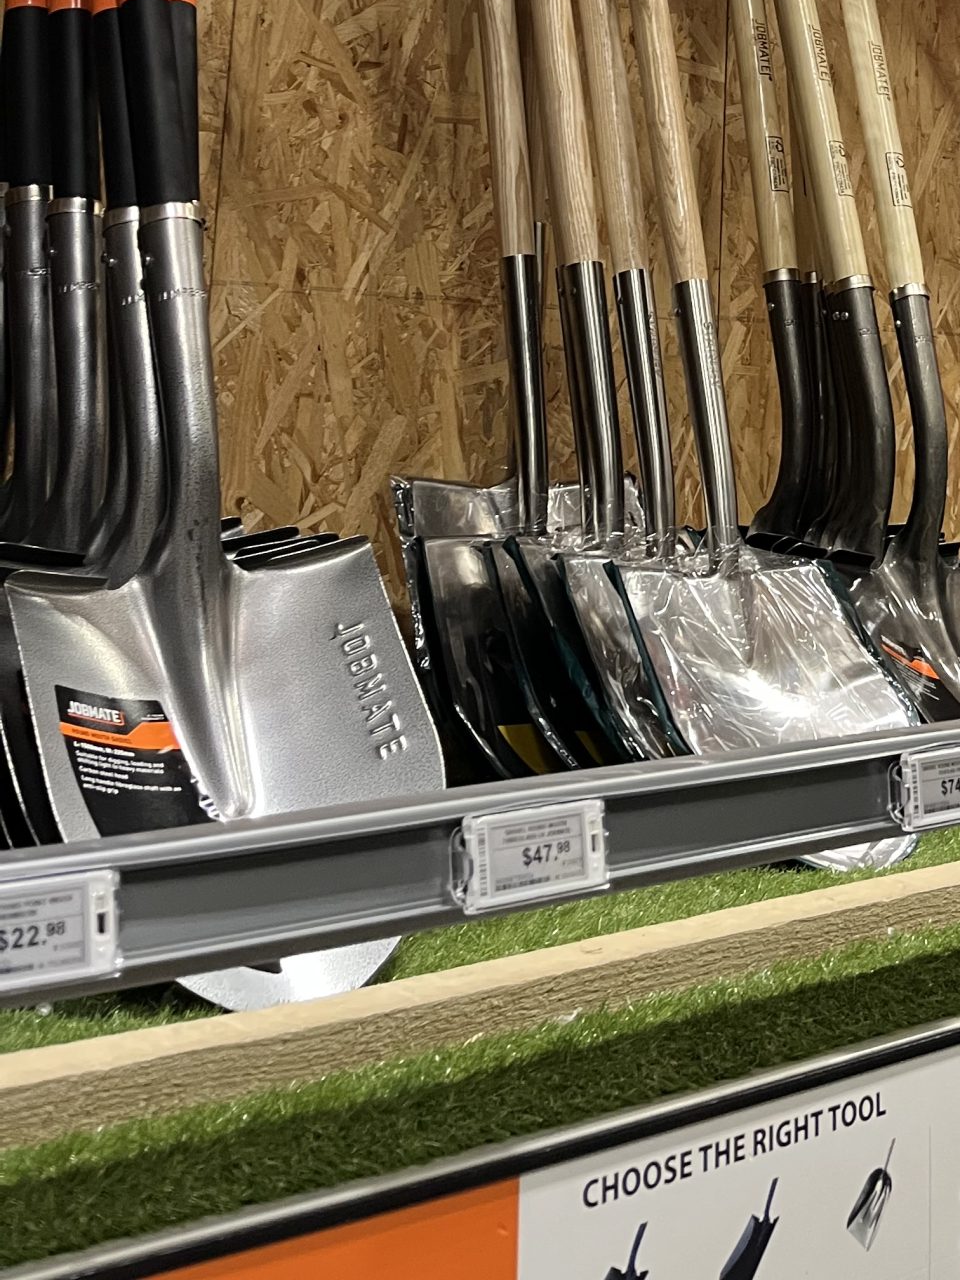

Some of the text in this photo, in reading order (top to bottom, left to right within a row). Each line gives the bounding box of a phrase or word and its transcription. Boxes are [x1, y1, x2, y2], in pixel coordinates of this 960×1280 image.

[755, 20, 771, 74] JOBMATE
[811, 25, 829, 80] JOBMATE
[871, 43, 890, 94] JOBMATE
[67, 700, 122, 724] JOBMATE
[336, 622, 408, 761] JOBMATE
[582, 1092, 887, 1208] CHOOSE THE RIGHT TOOL
